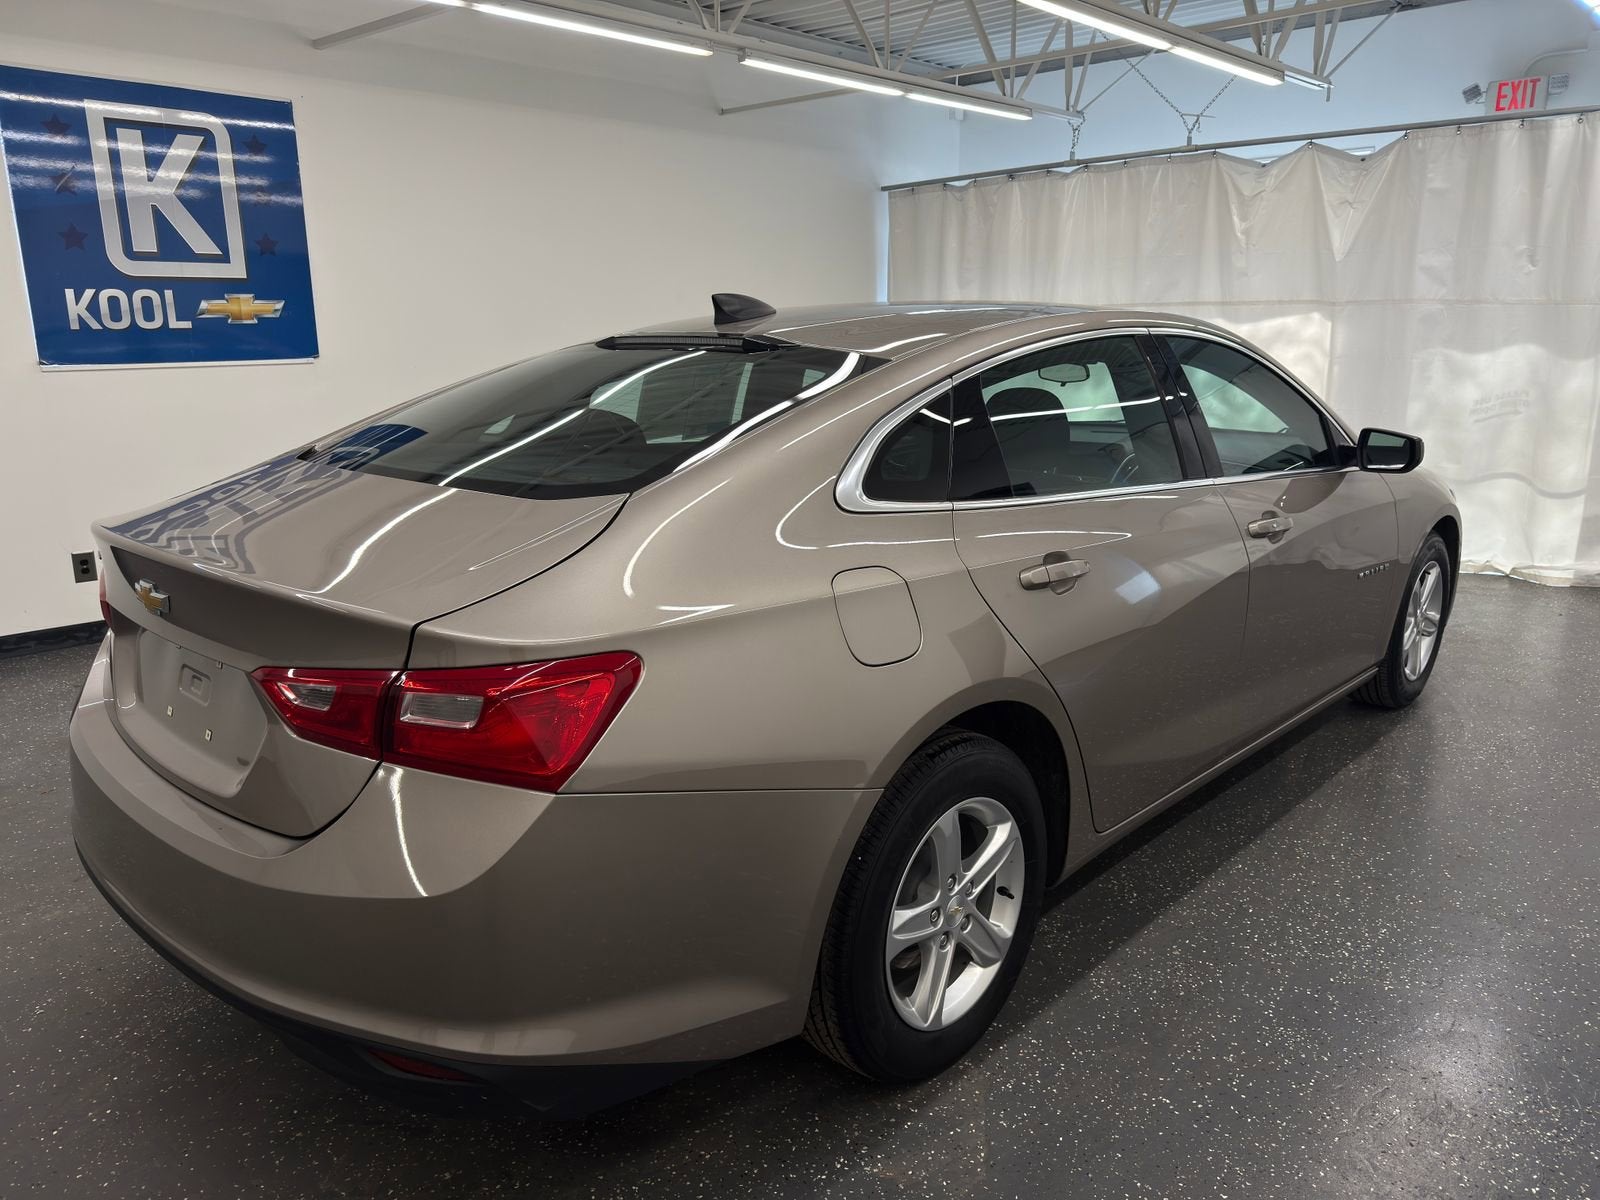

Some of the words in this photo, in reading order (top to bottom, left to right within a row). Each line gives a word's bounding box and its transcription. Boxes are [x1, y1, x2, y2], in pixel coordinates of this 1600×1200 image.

[1495, 78, 1541, 112] EXIT
[116, 127, 223, 255] K
[64, 288, 193, 330] KOOL
